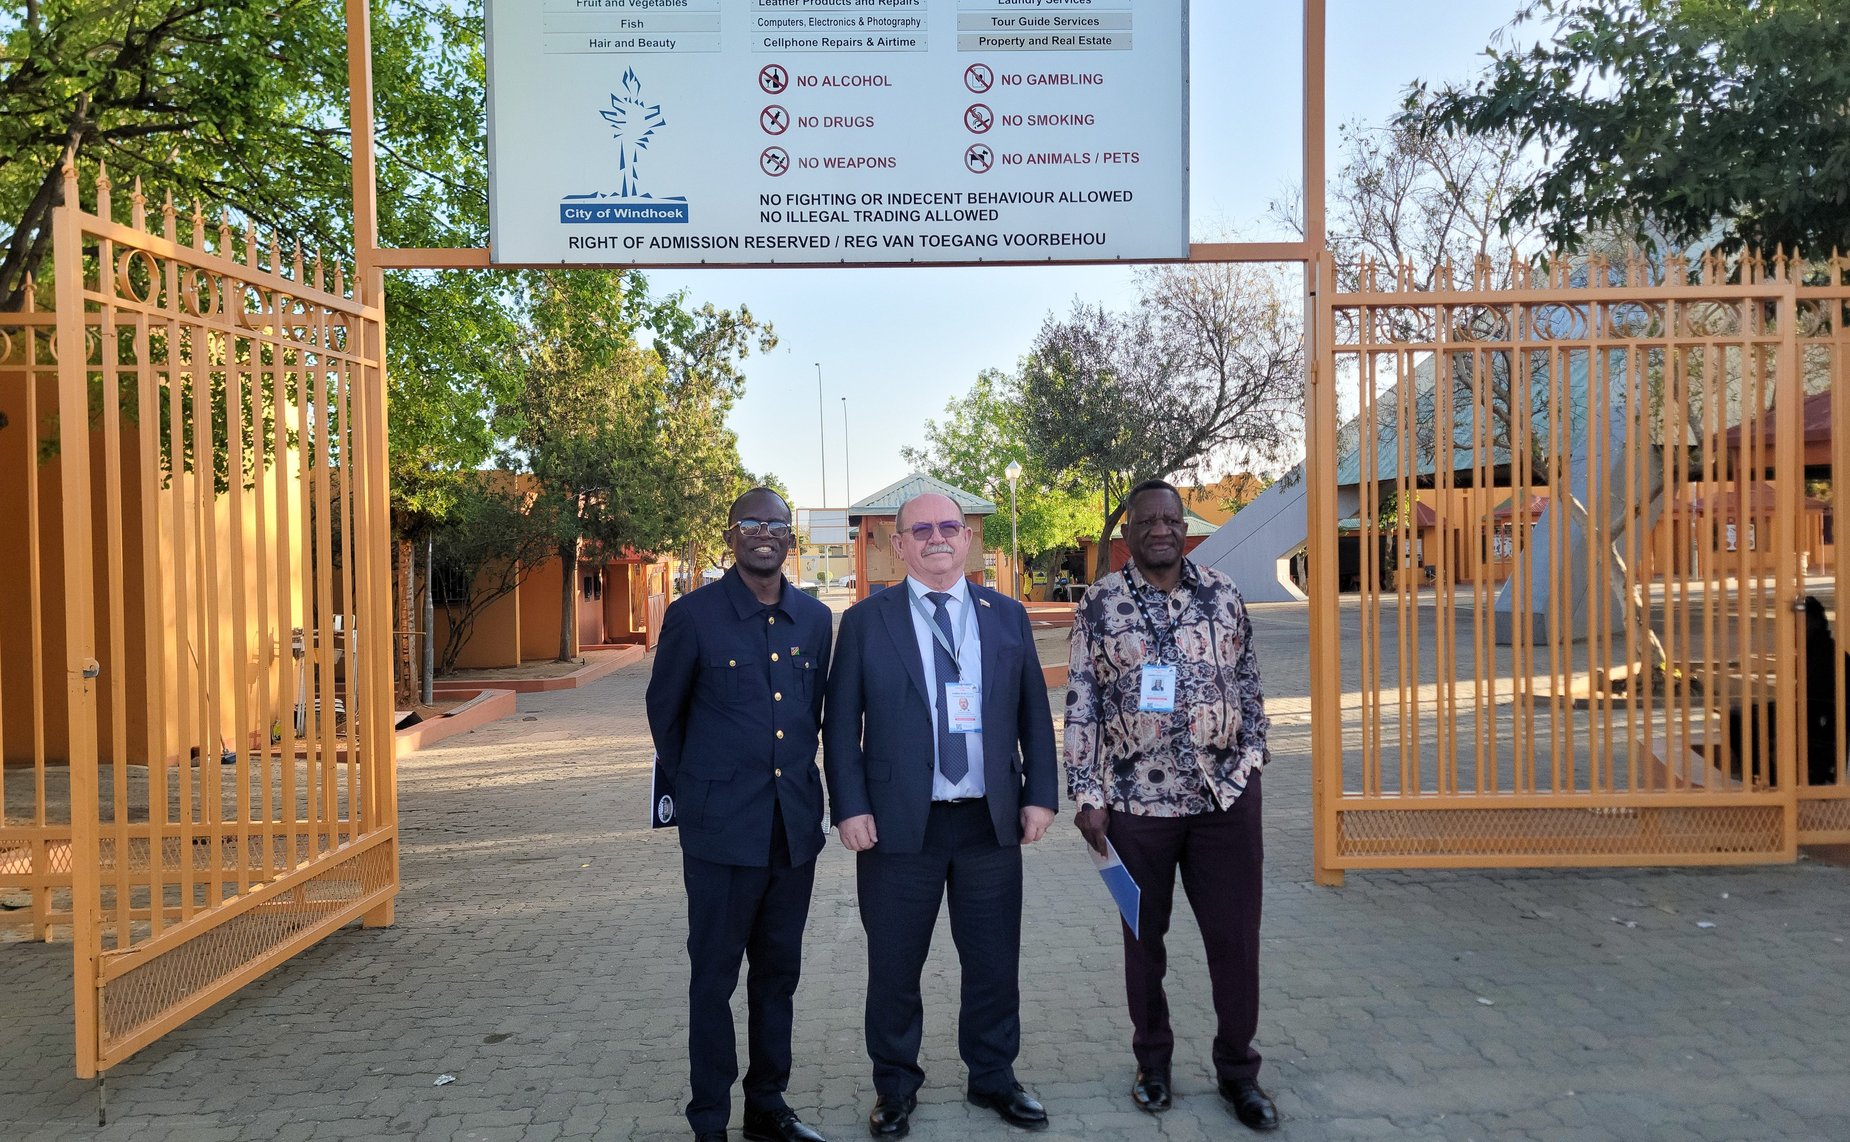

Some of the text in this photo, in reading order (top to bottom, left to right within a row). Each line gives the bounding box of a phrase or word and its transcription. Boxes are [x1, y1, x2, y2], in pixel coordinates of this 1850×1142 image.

[620, 19, 644, 29] Fish
[757, 16, 921, 29] Computers, Electronics & Photography
[991, 16, 1100, 27] Tour Guide Services
[589, 38, 676, 50] Hair and Beauty
[763, 37, 916, 49] Cellphone Repairs & Airtime
[979, 35, 1112, 48] Property and Real Estate
[797, 74, 893, 87] NO ALCOHOL
[1001, 73, 1104, 86] NO GAMBLING
[798, 115, 875, 128] NO DRUGS
[1002, 114, 1095, 127] NO SMOKING
[798, 156, 897, 169] NO WEAPONS
[1002, 153, 1023, 165] NO
[1026, 152, 1091, 165] ANIMALS
[1103, 151, 1140, 164] PETS
[759, 190, 1133, 206] NO FIGHTING OR INDECENT BEHAVIOUR ALLOWED
[564, 208, 684, 221] City of Windhoek
[760, 209, 999, 223] NO ILLEGAL TRADING ALLOWED
[568, 236, 619, 249] RIGHT
[623, 236, 645, 249] OF
[649, 235, 739, 249] ADMISSION
[744, 235, 831, 249] RESERVED
[844, 234, 878, 248] REG
[882, 234, 914, 248] VAN
[918, 233, 998, 248] TOEGANG
[1002, 232, 1106, 247] VOORBEHOU
